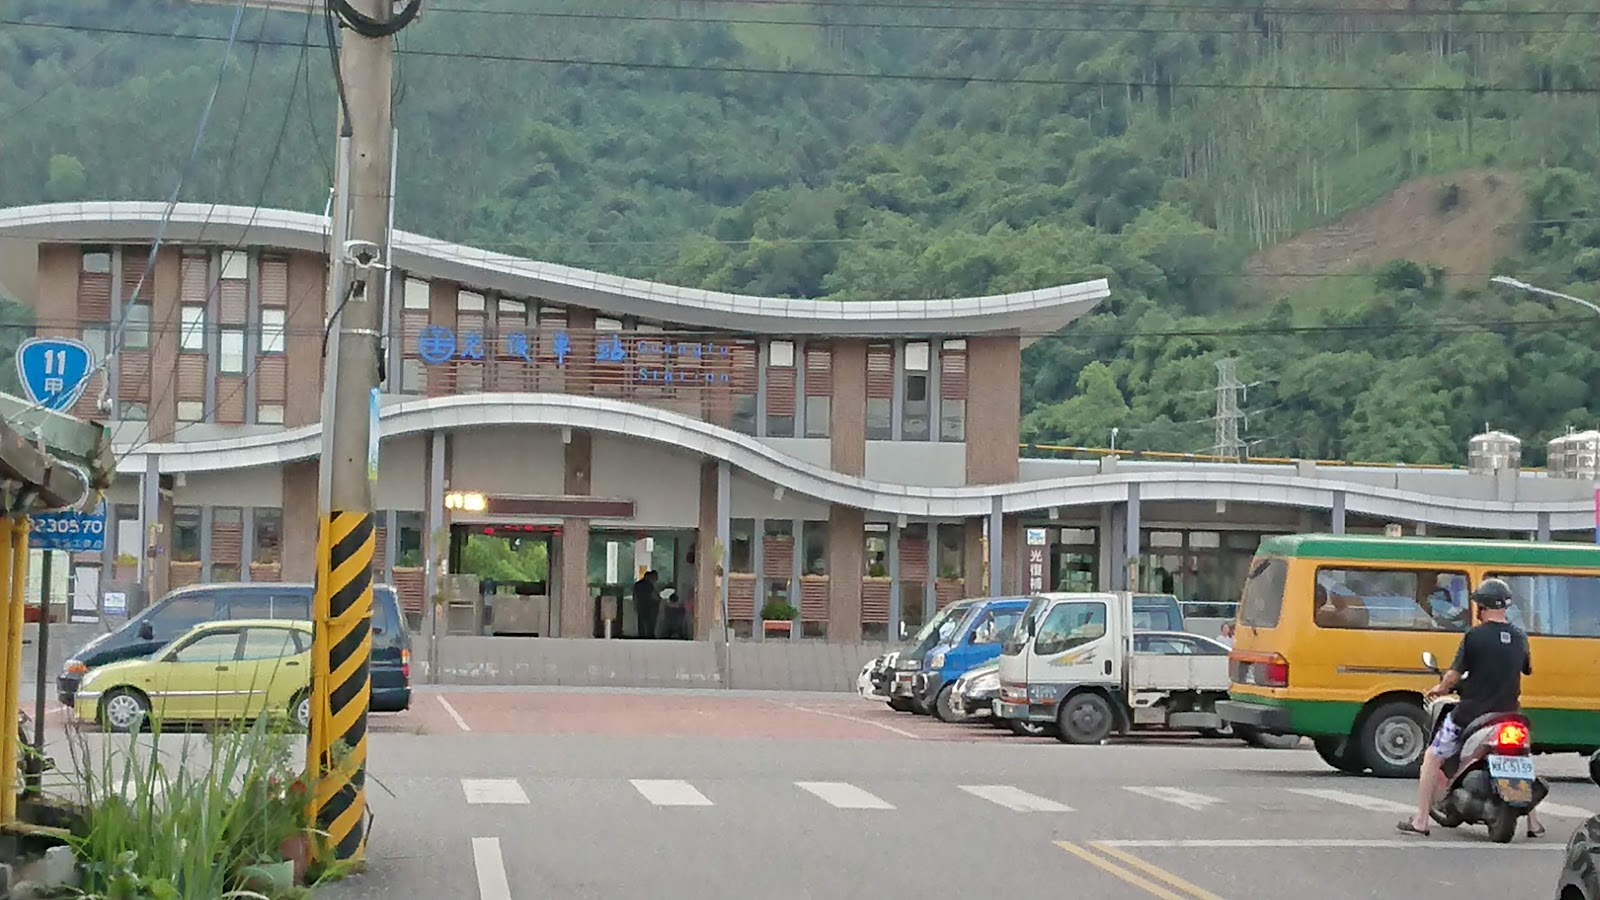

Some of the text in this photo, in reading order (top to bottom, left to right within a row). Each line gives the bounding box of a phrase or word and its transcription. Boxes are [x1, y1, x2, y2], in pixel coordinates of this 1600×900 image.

[44, 349, 67, 376] 11
[638, 368, 729, 384] Station
[44, 377, 64, 396] 甲
